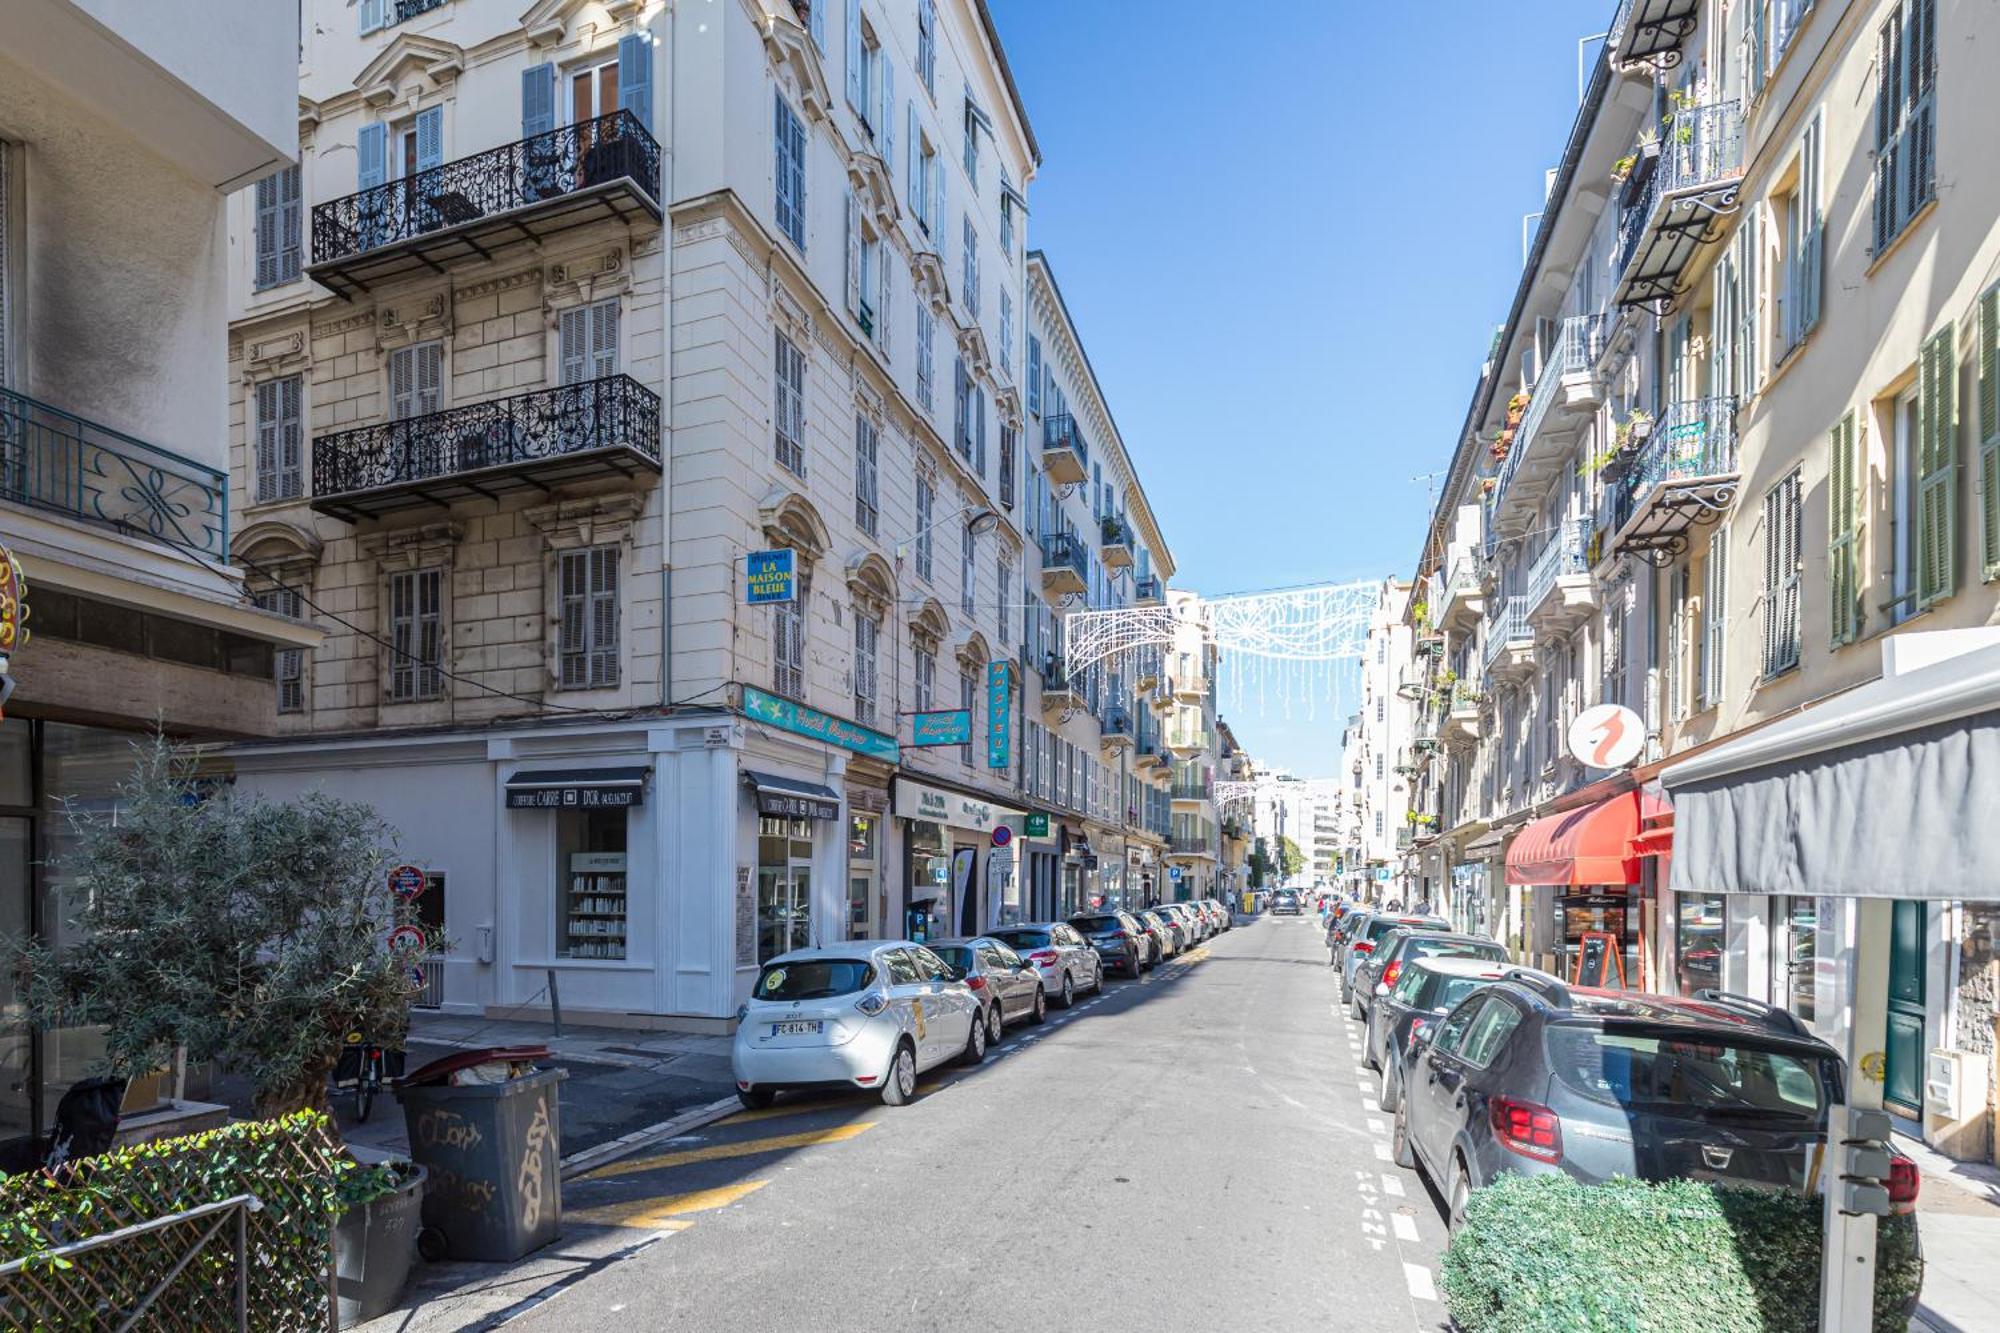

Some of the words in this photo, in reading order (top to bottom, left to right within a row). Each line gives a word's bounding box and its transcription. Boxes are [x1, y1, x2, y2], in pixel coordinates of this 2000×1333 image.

[762, 561, 777, 573] LA
[748, 571, 792, 584] MAISON
[753, 582, 785, 595] BLEUE
[992, 663, 1005, 749] HOSTEL
[916, 913, 924, 924] P
[1355, 1170, 1388, 1251] PAYANT
